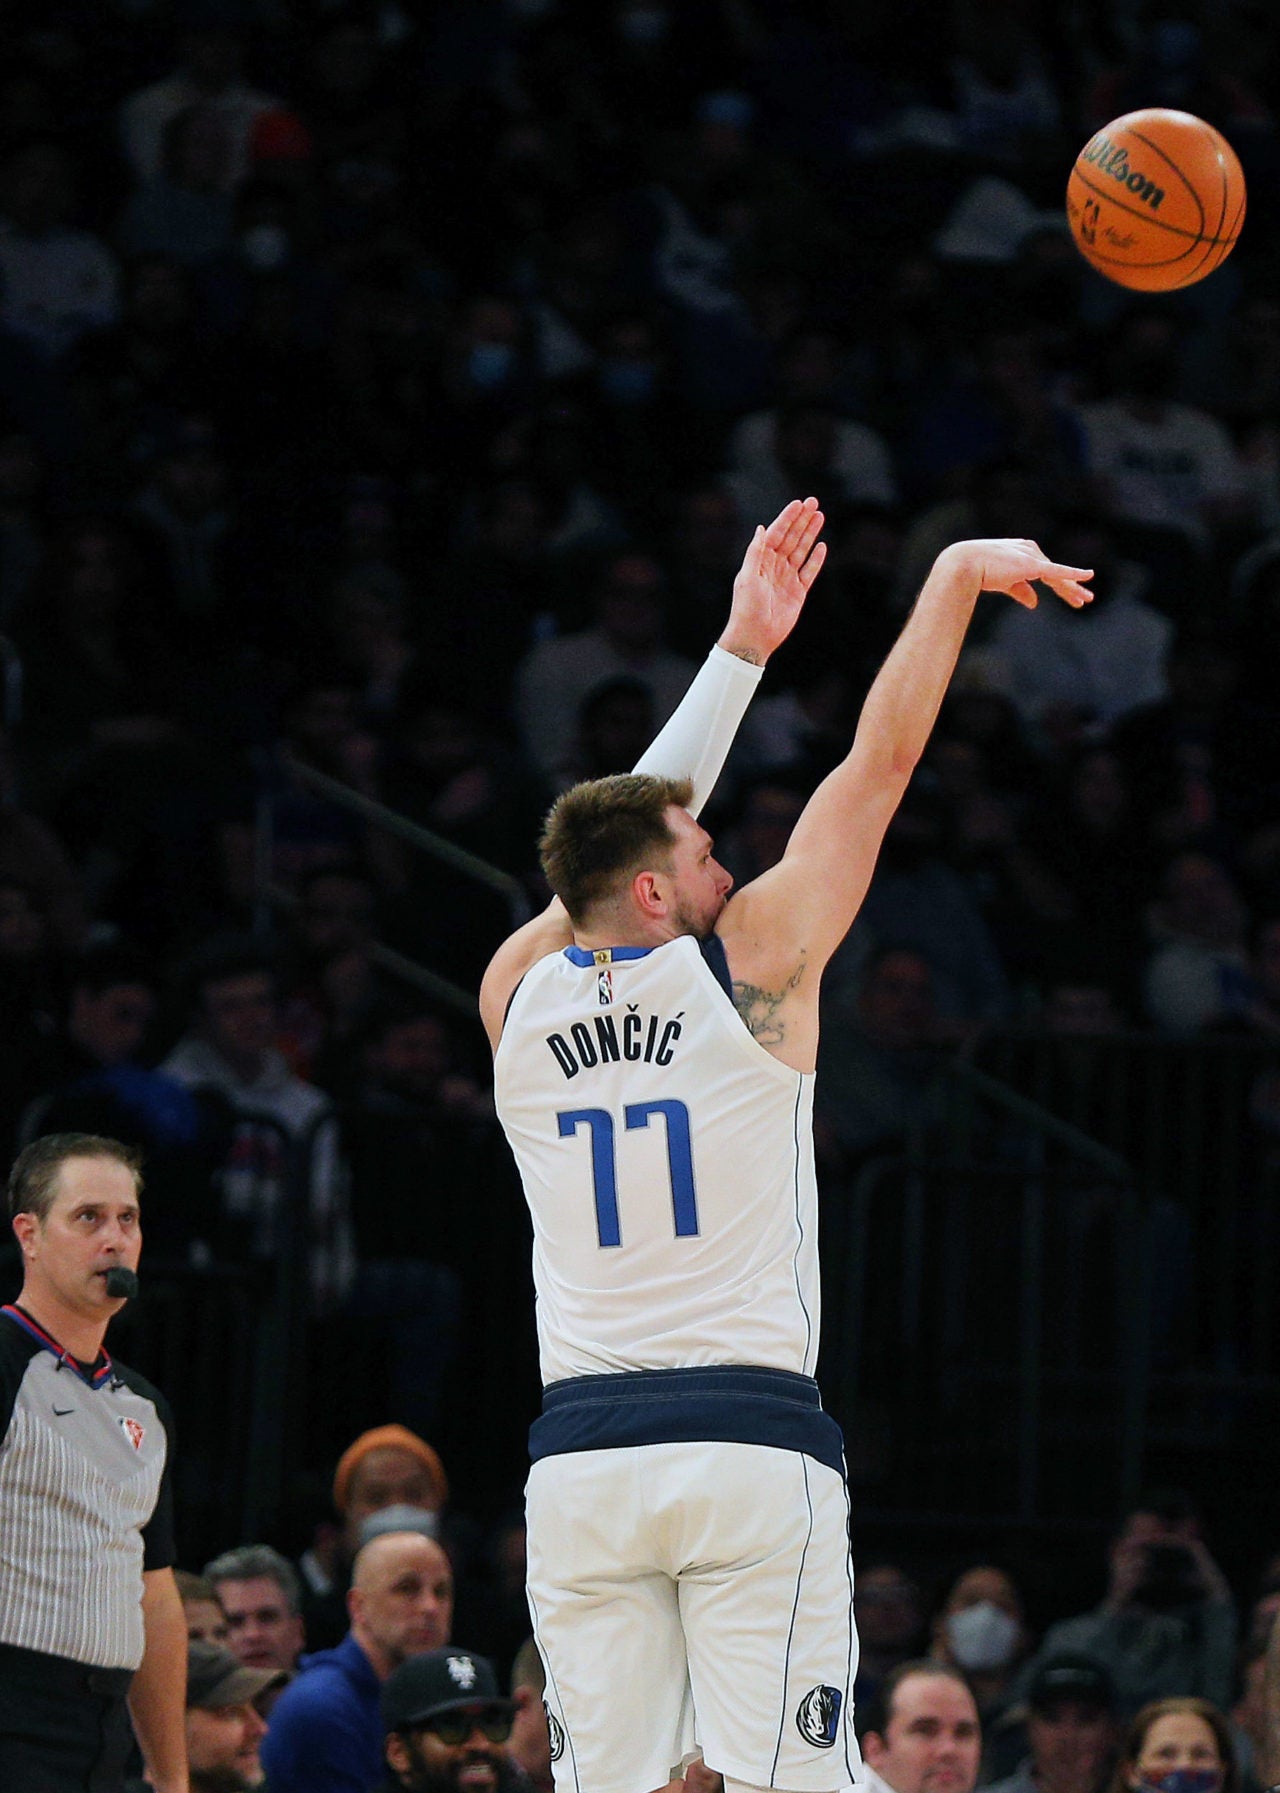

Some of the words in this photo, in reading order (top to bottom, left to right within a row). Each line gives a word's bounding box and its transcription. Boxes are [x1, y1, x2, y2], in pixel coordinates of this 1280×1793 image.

[1083, 136, 1165, 210] Wilson
[546, 1003, 685, 1080] DONČIĆ
[556, 1098, 701, 1249] 77
